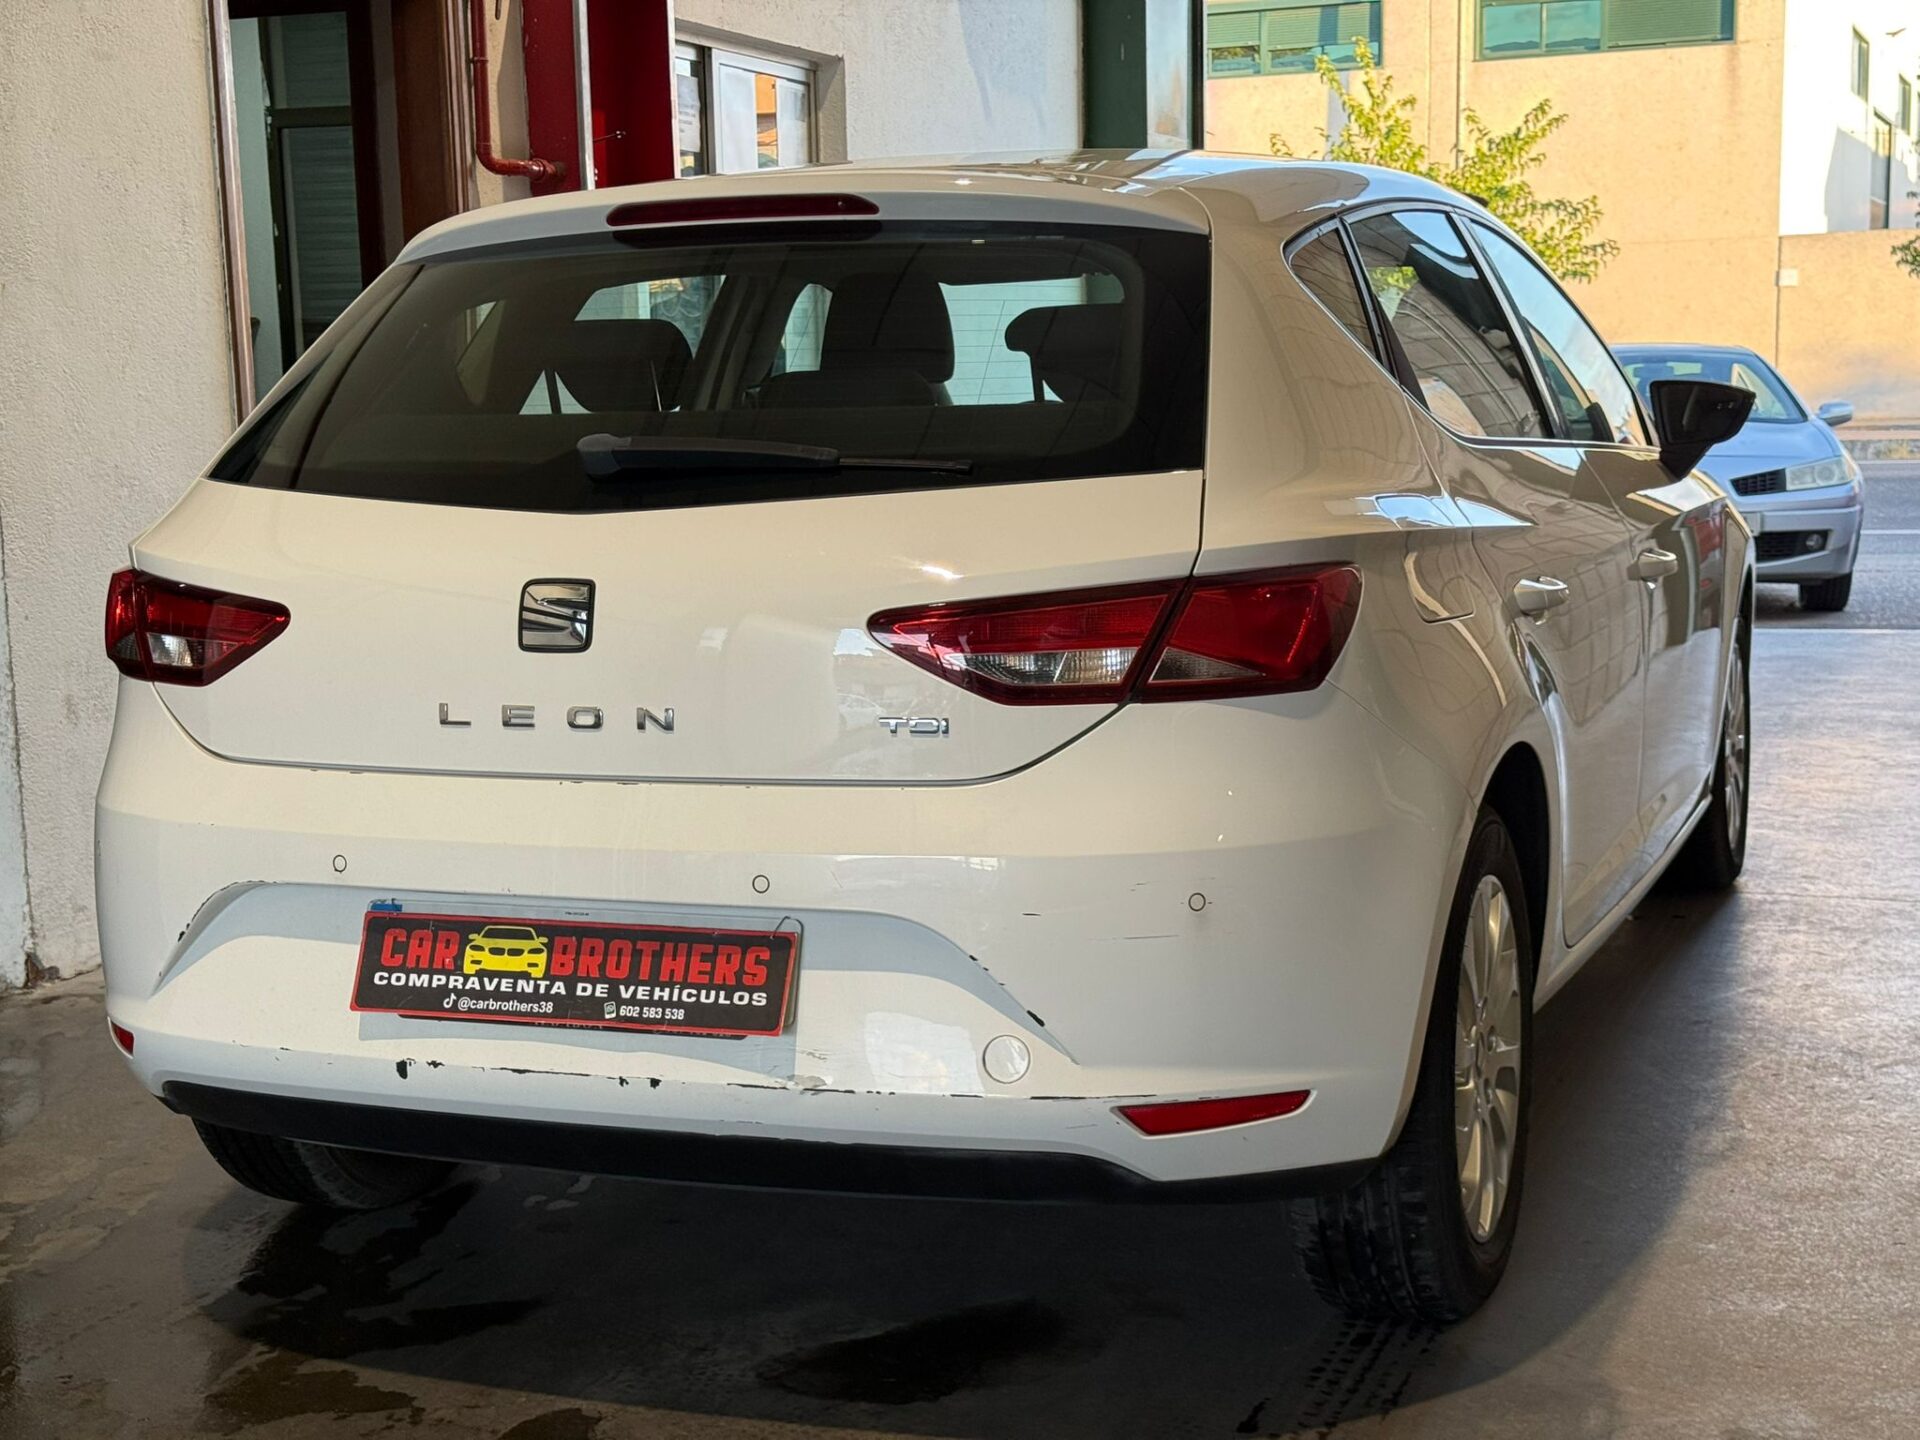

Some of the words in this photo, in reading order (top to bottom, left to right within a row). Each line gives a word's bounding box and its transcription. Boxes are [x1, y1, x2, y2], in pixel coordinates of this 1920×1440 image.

[438, 702, 675, 732] LEON
[879, 716, 949, 735] TDI
[381, 928, 460, 970] CAR
[550, 935, 770, 987] BROTHERS
[373, 971, 567, 996] COMPRAVENTA
[576, 982, 609, 998] DE
[619, 984, 768, 1007] VEHÍCULOS
[458, 996, 554, 1014] @carbrothers38
[619, 1005, 640, 1018] 602
[642, 1007, 663, 1019] 583
[664, 1008, 685, 1020] 538
